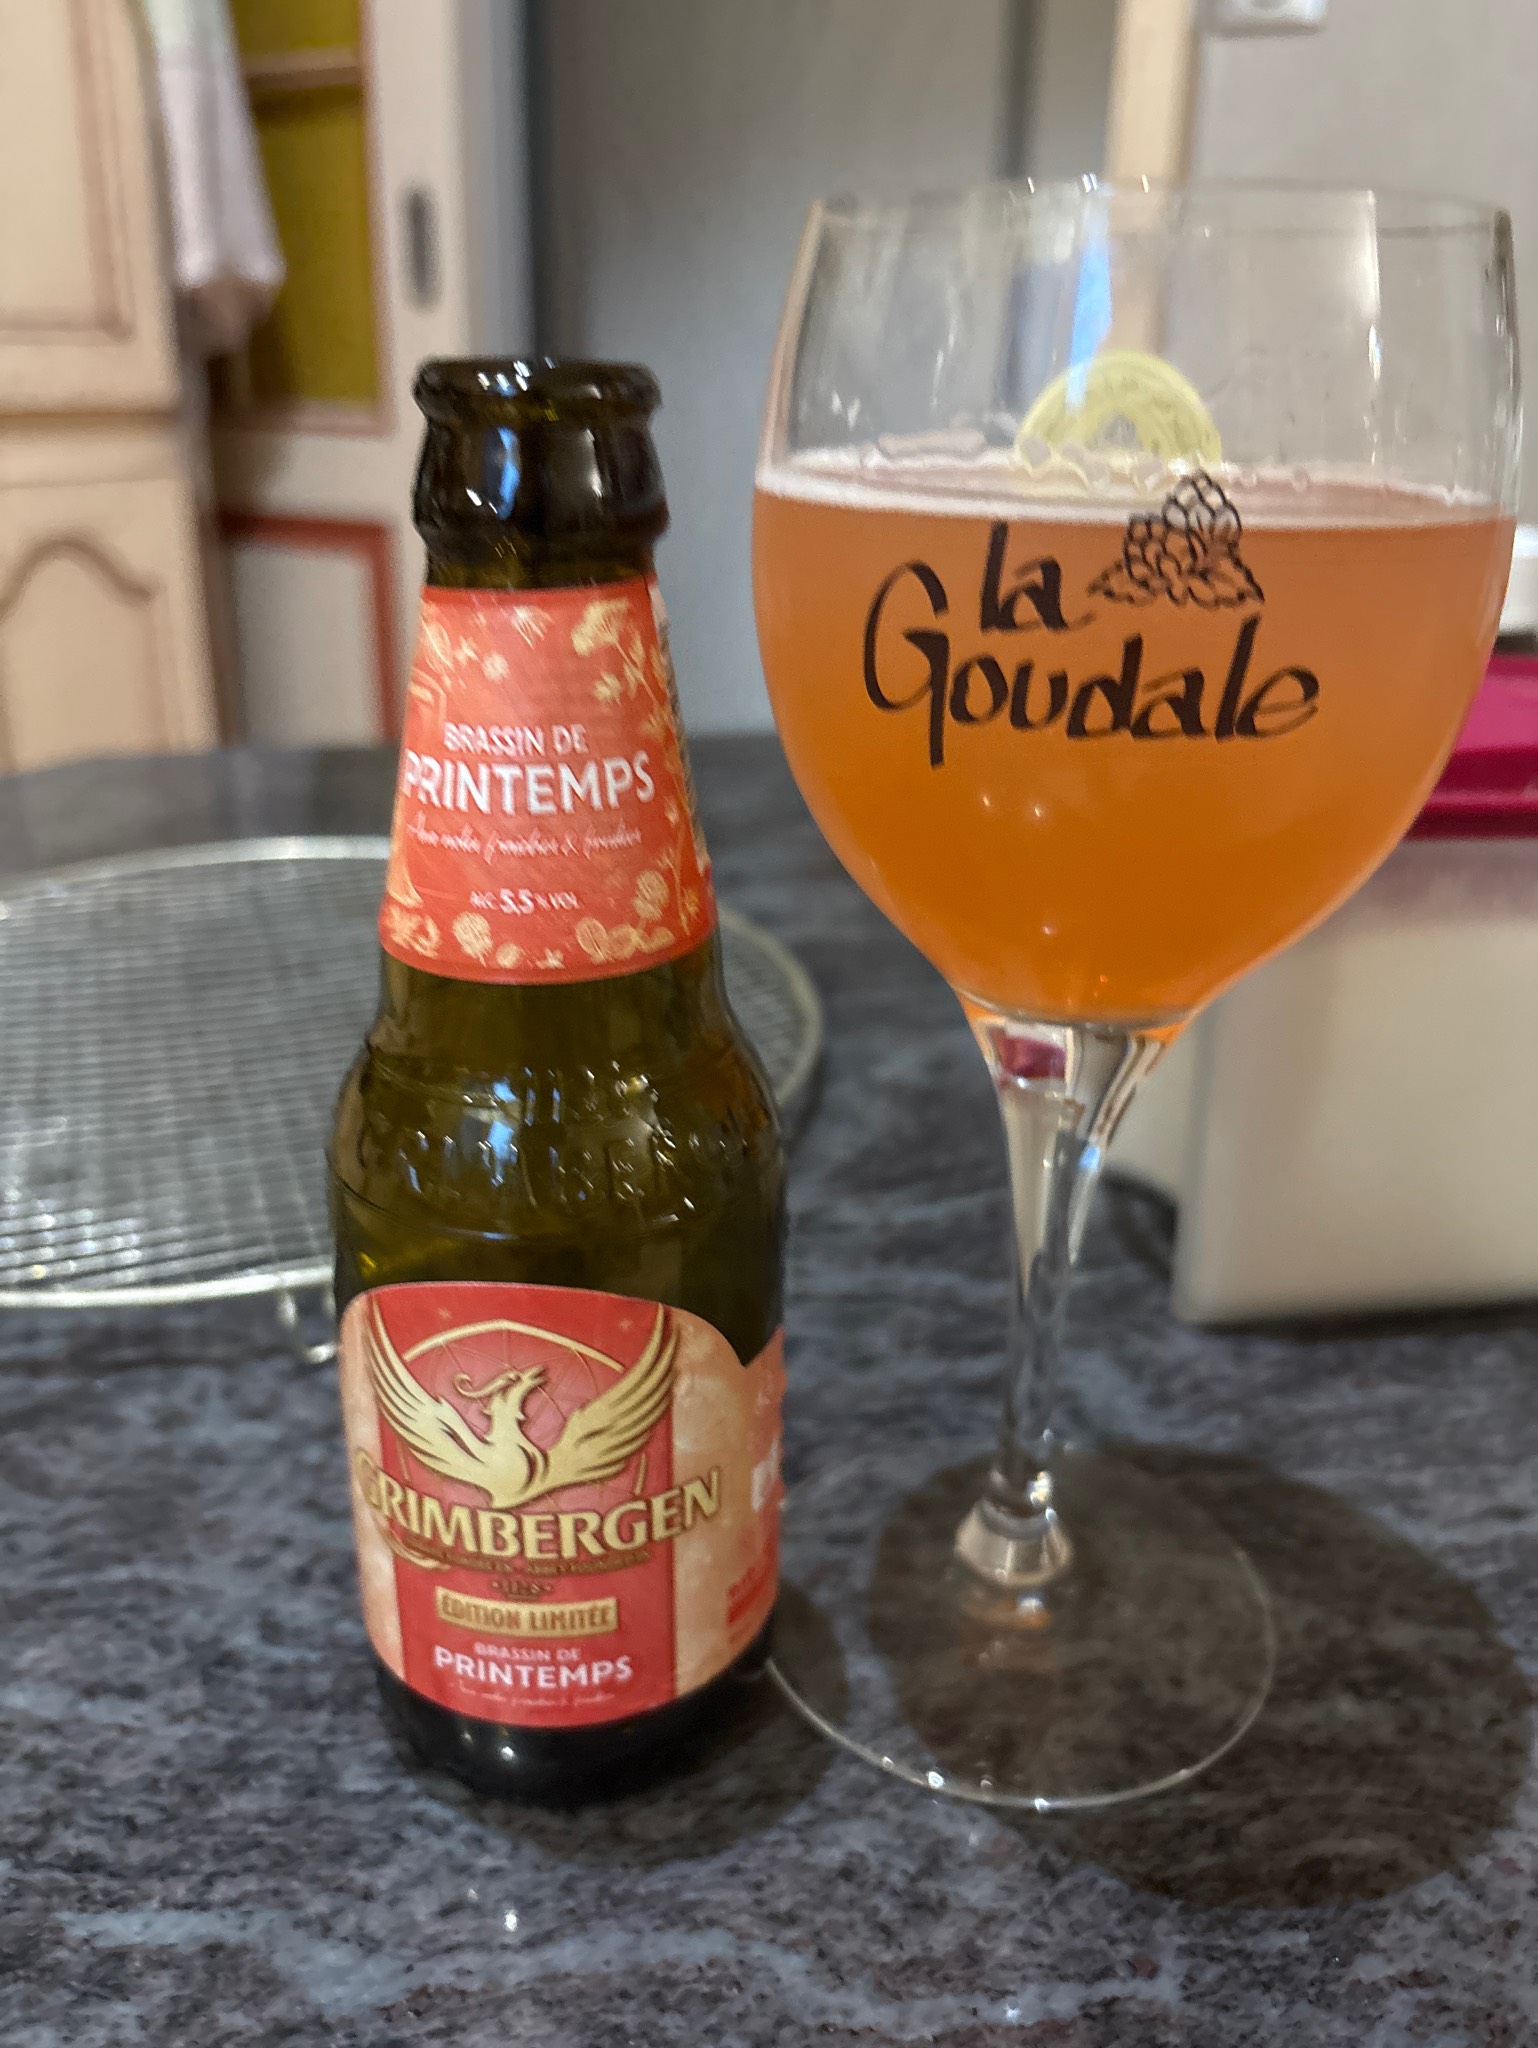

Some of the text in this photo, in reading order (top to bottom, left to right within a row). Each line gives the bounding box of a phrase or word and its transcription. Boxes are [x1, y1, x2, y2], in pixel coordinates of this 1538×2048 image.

[864, 559, 1320, 769] Goudale
[444, 721, 589, 757] BRASSIN DE
[402, 749, 656, 816] PRINTEMPS
[354, 1448, 723, 1560] GRIMBERGEN
[434, 1645, 633, 1690] PRINTEMPS
[474, 1642, 580, 1662] BRASSIN DE
